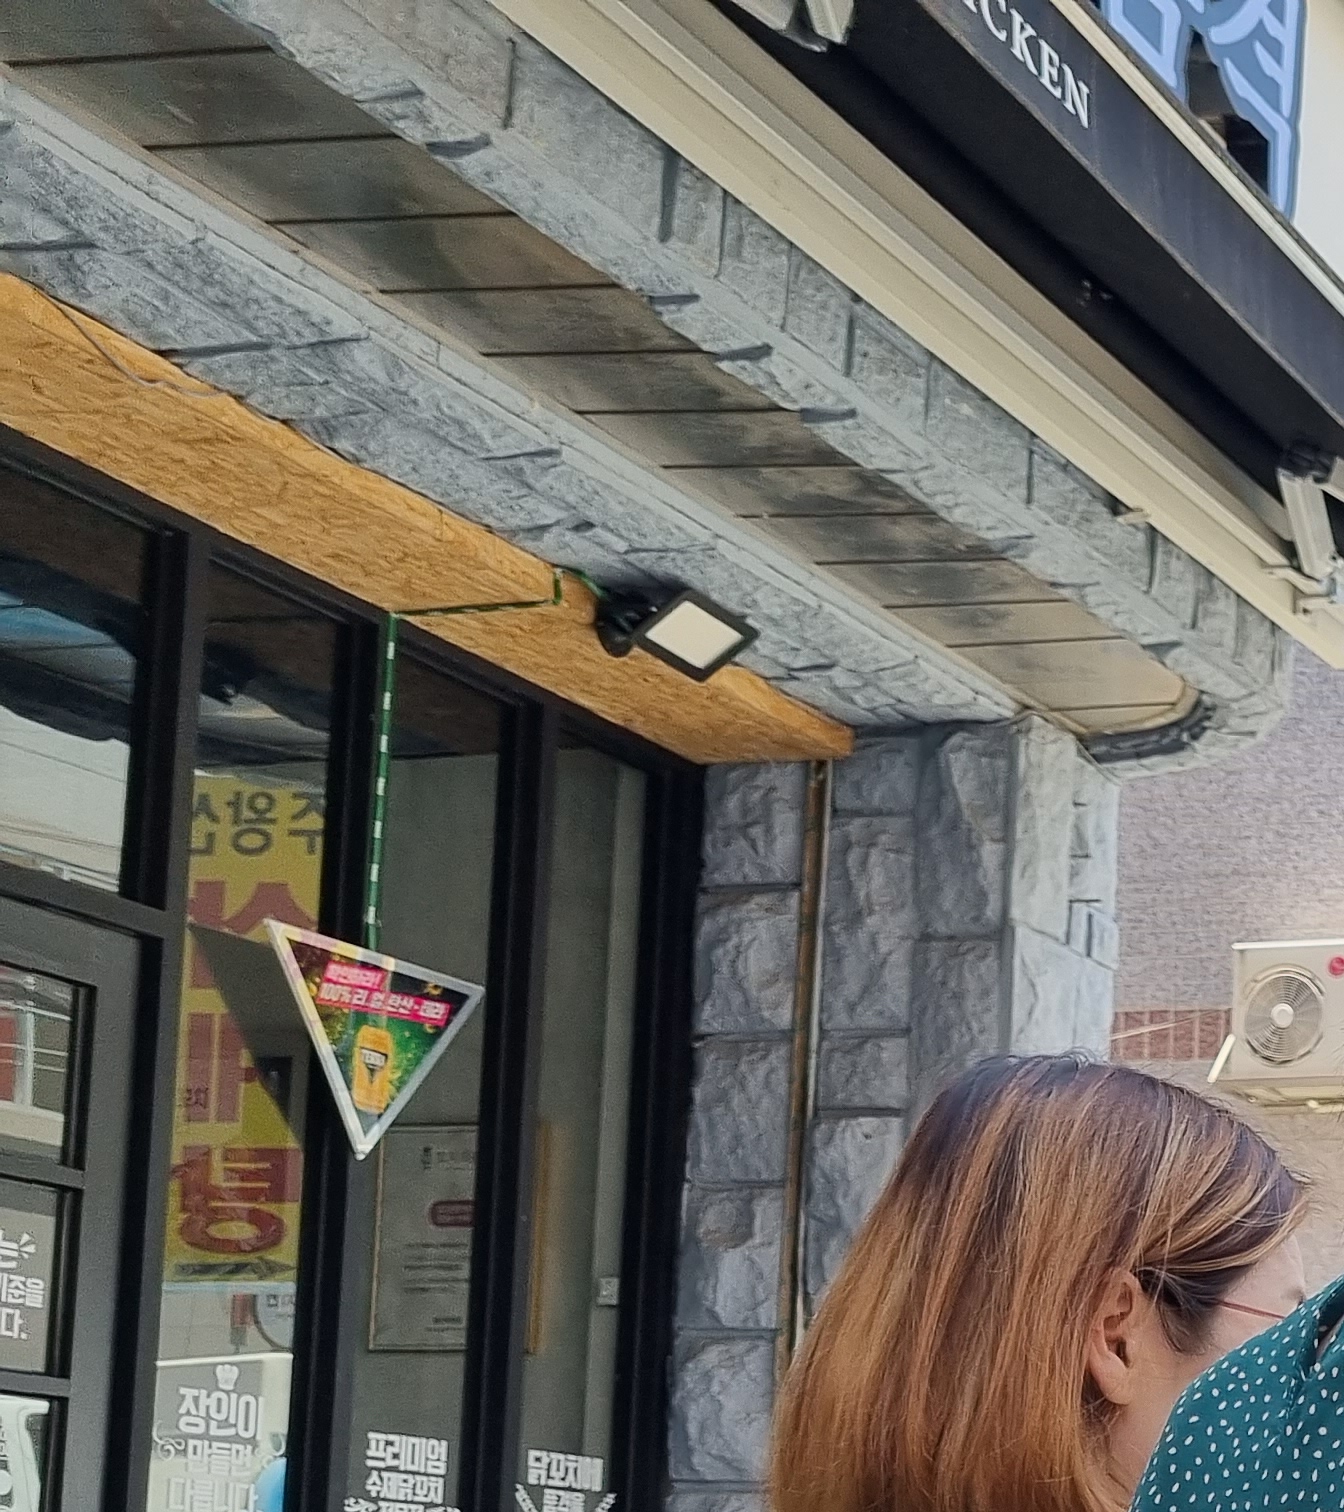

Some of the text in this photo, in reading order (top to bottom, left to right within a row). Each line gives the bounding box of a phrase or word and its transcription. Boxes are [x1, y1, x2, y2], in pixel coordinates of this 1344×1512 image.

[963, 0, 1091, 130] CKEN
[178, 1386, 264, 1439] 장인이
[186, 1439, 255, 1478] 만들면
[366, 1430, 450, 1475] 프리미엄
